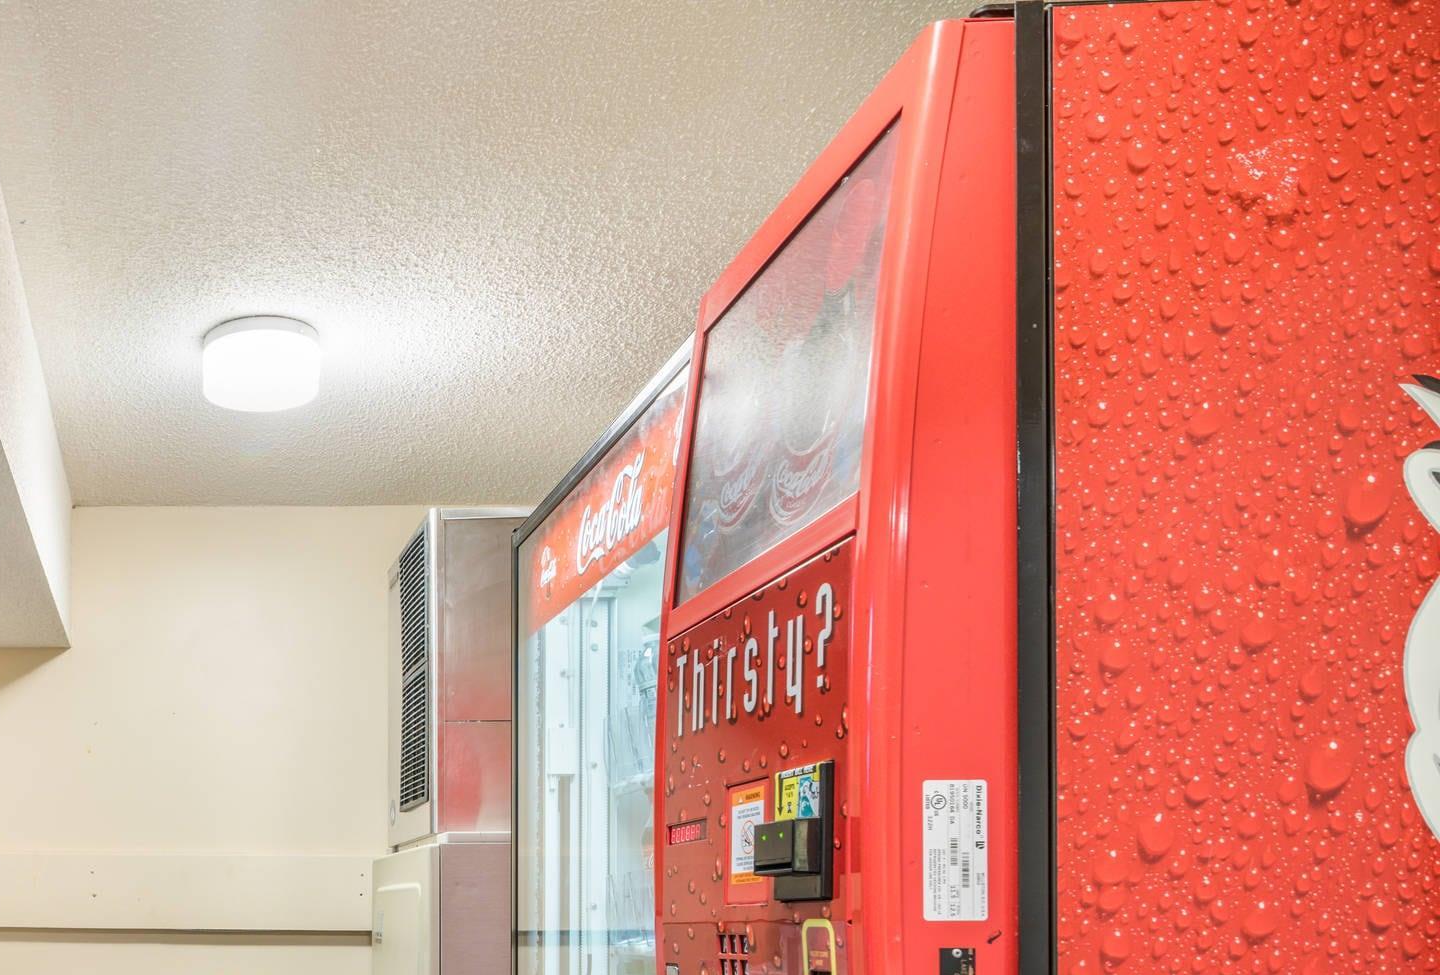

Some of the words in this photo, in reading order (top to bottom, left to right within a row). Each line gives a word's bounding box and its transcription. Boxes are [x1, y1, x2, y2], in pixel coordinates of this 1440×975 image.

[576, 450, 645, 575] Coca-Cola
[677, 583, 833, 737] Thirsty?
[975, 785, 983, 835] Dixie-Narco
